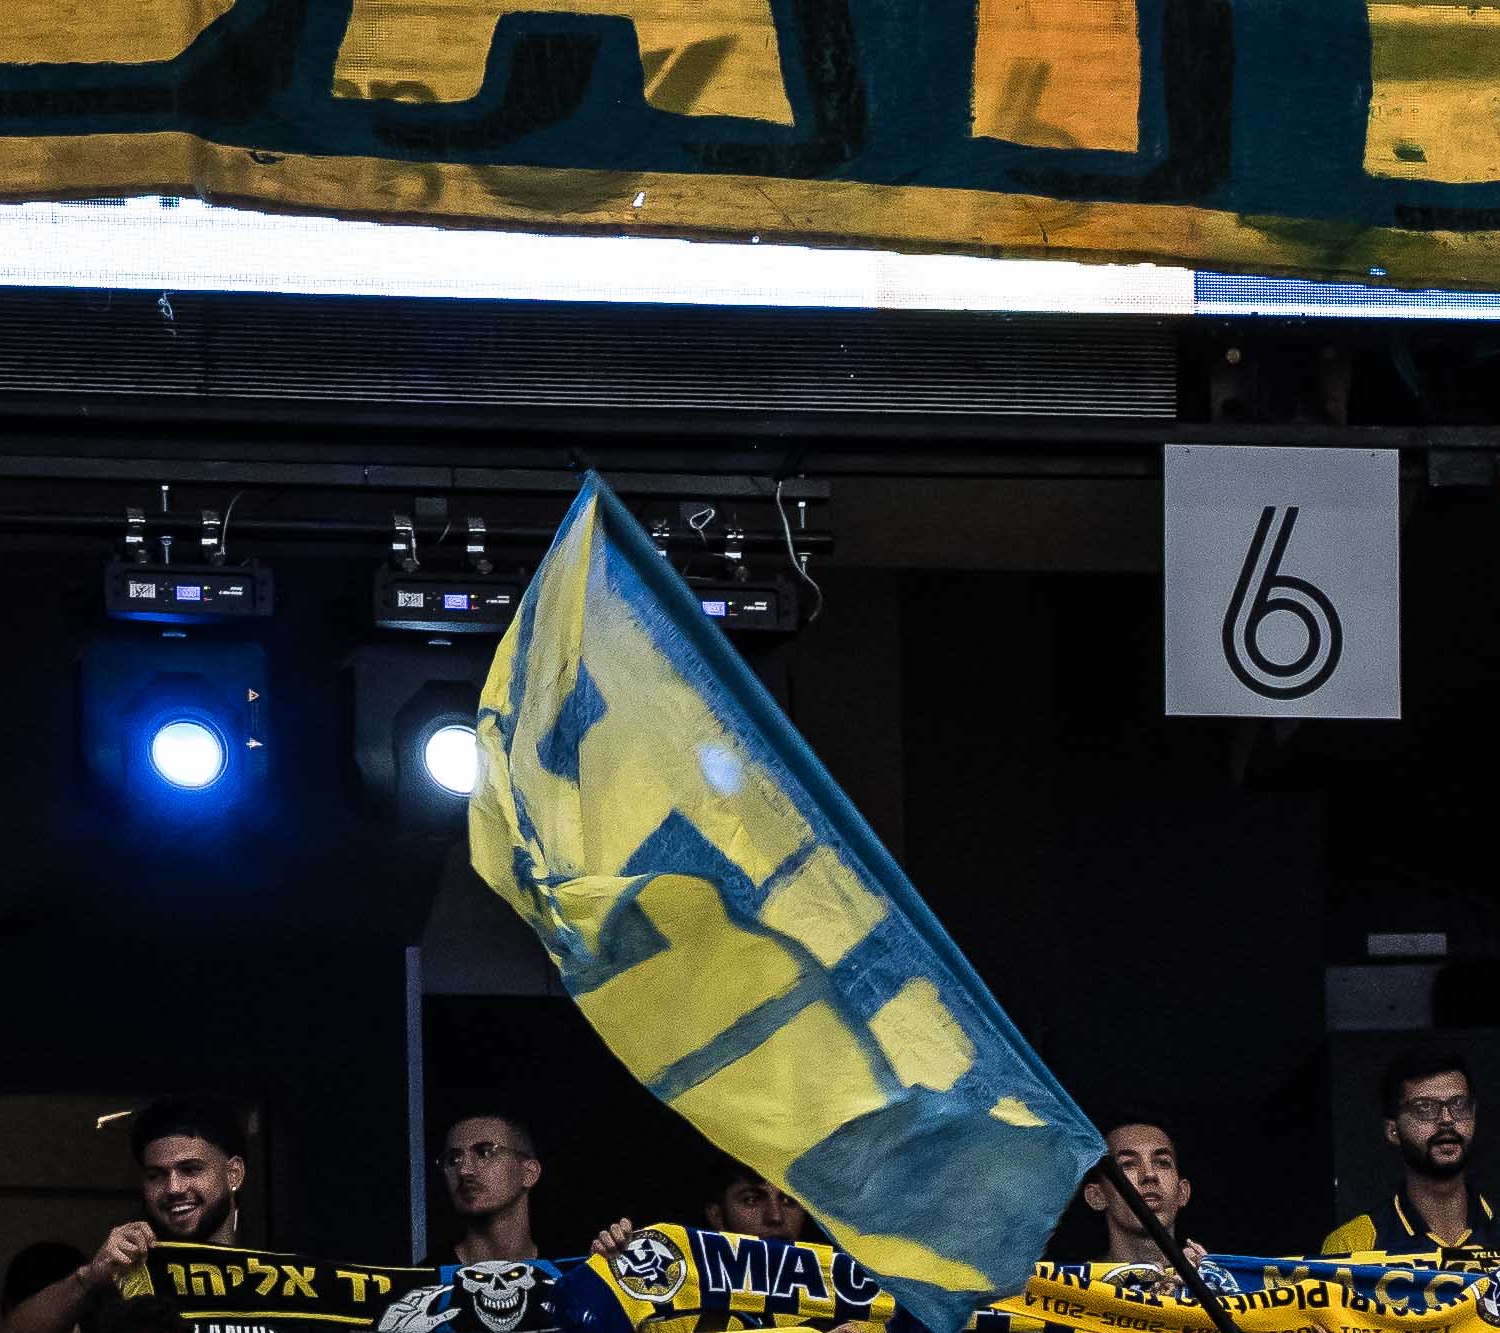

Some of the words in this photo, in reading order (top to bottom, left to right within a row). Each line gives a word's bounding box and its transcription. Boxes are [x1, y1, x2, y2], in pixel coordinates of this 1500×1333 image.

[1221, 505, 1344, 701] 6
[166, 1258, 319, 1300] אליהו
[335, 1269, 392, 1303] יד
